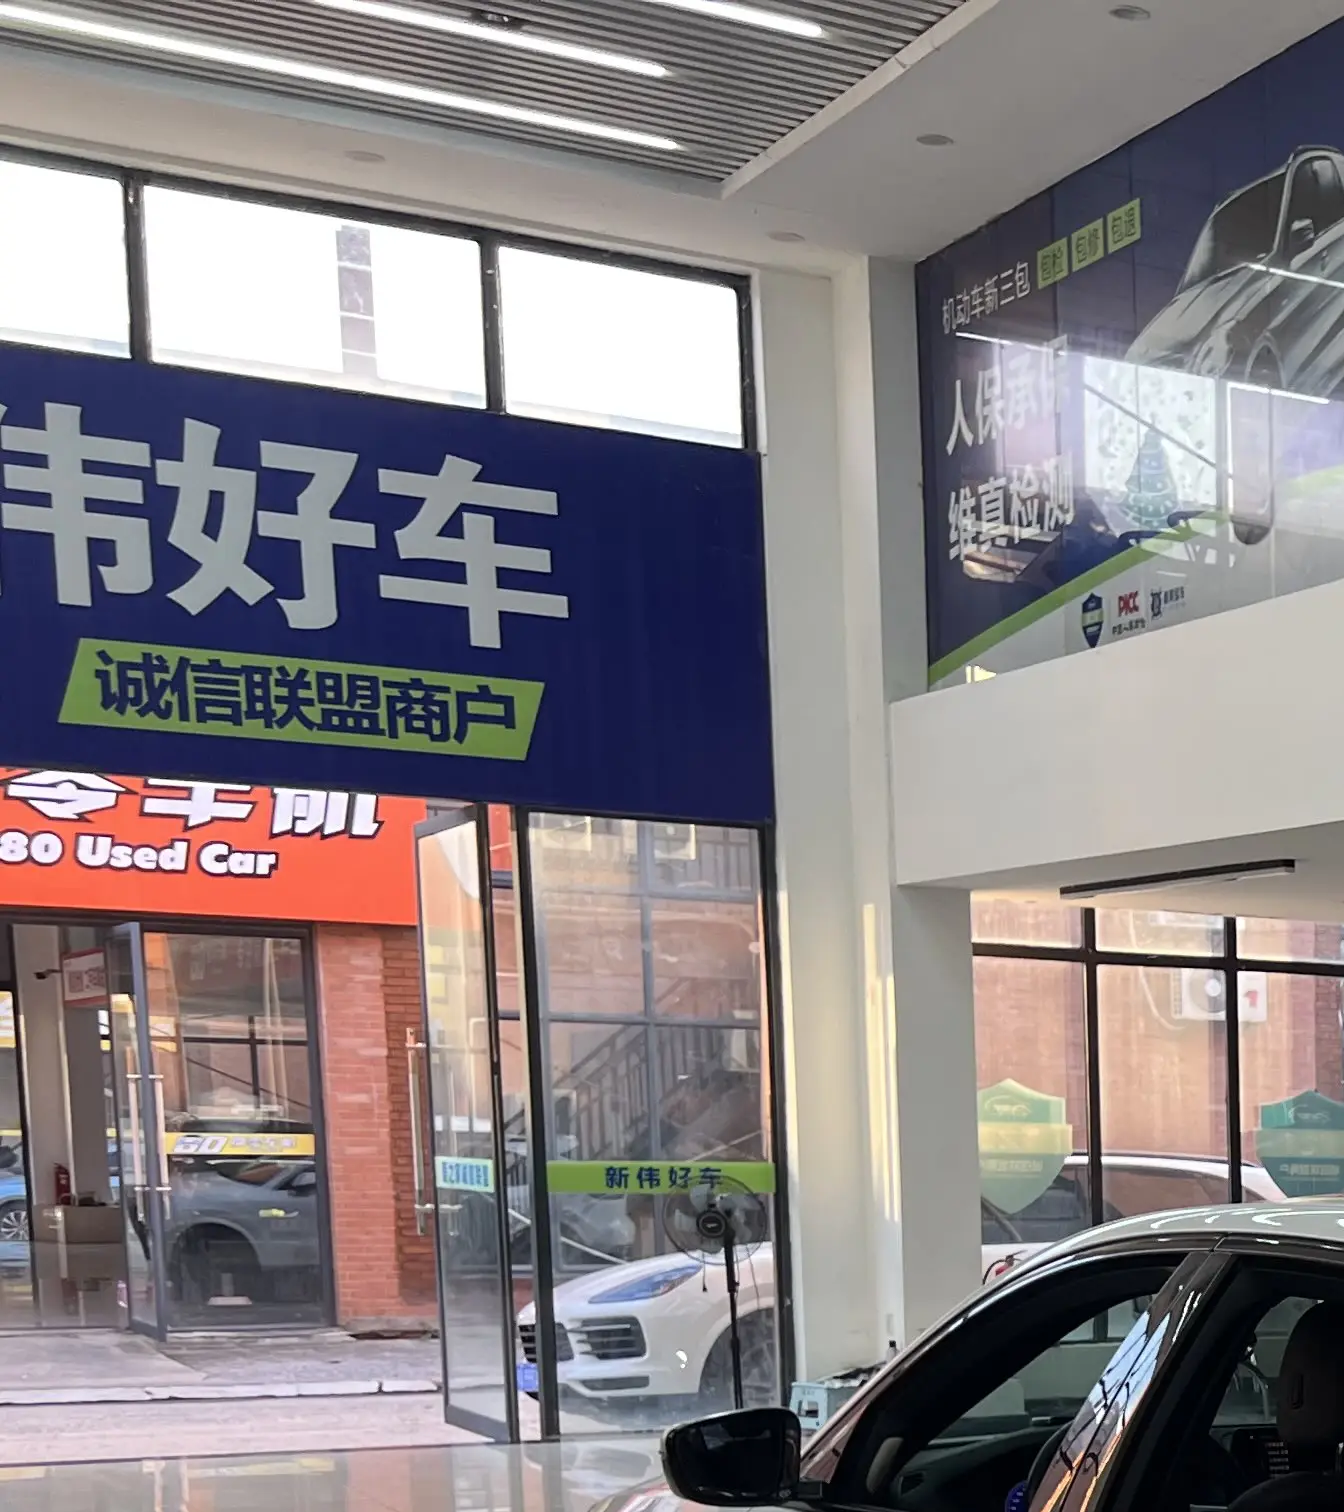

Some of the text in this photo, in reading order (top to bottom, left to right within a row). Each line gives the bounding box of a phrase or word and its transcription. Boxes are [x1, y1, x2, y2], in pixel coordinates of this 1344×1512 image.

[943, 260, 1031, 335] 机动车新三包
[948, 453, 1075, 561] 维真检测
[95, 649, 517, 745] 诚信联盟商户
[76, 833, 190, 873] Used
[198, 841, 278, 877] Car
[605, 1166, 722, 1189] 新伟好车
